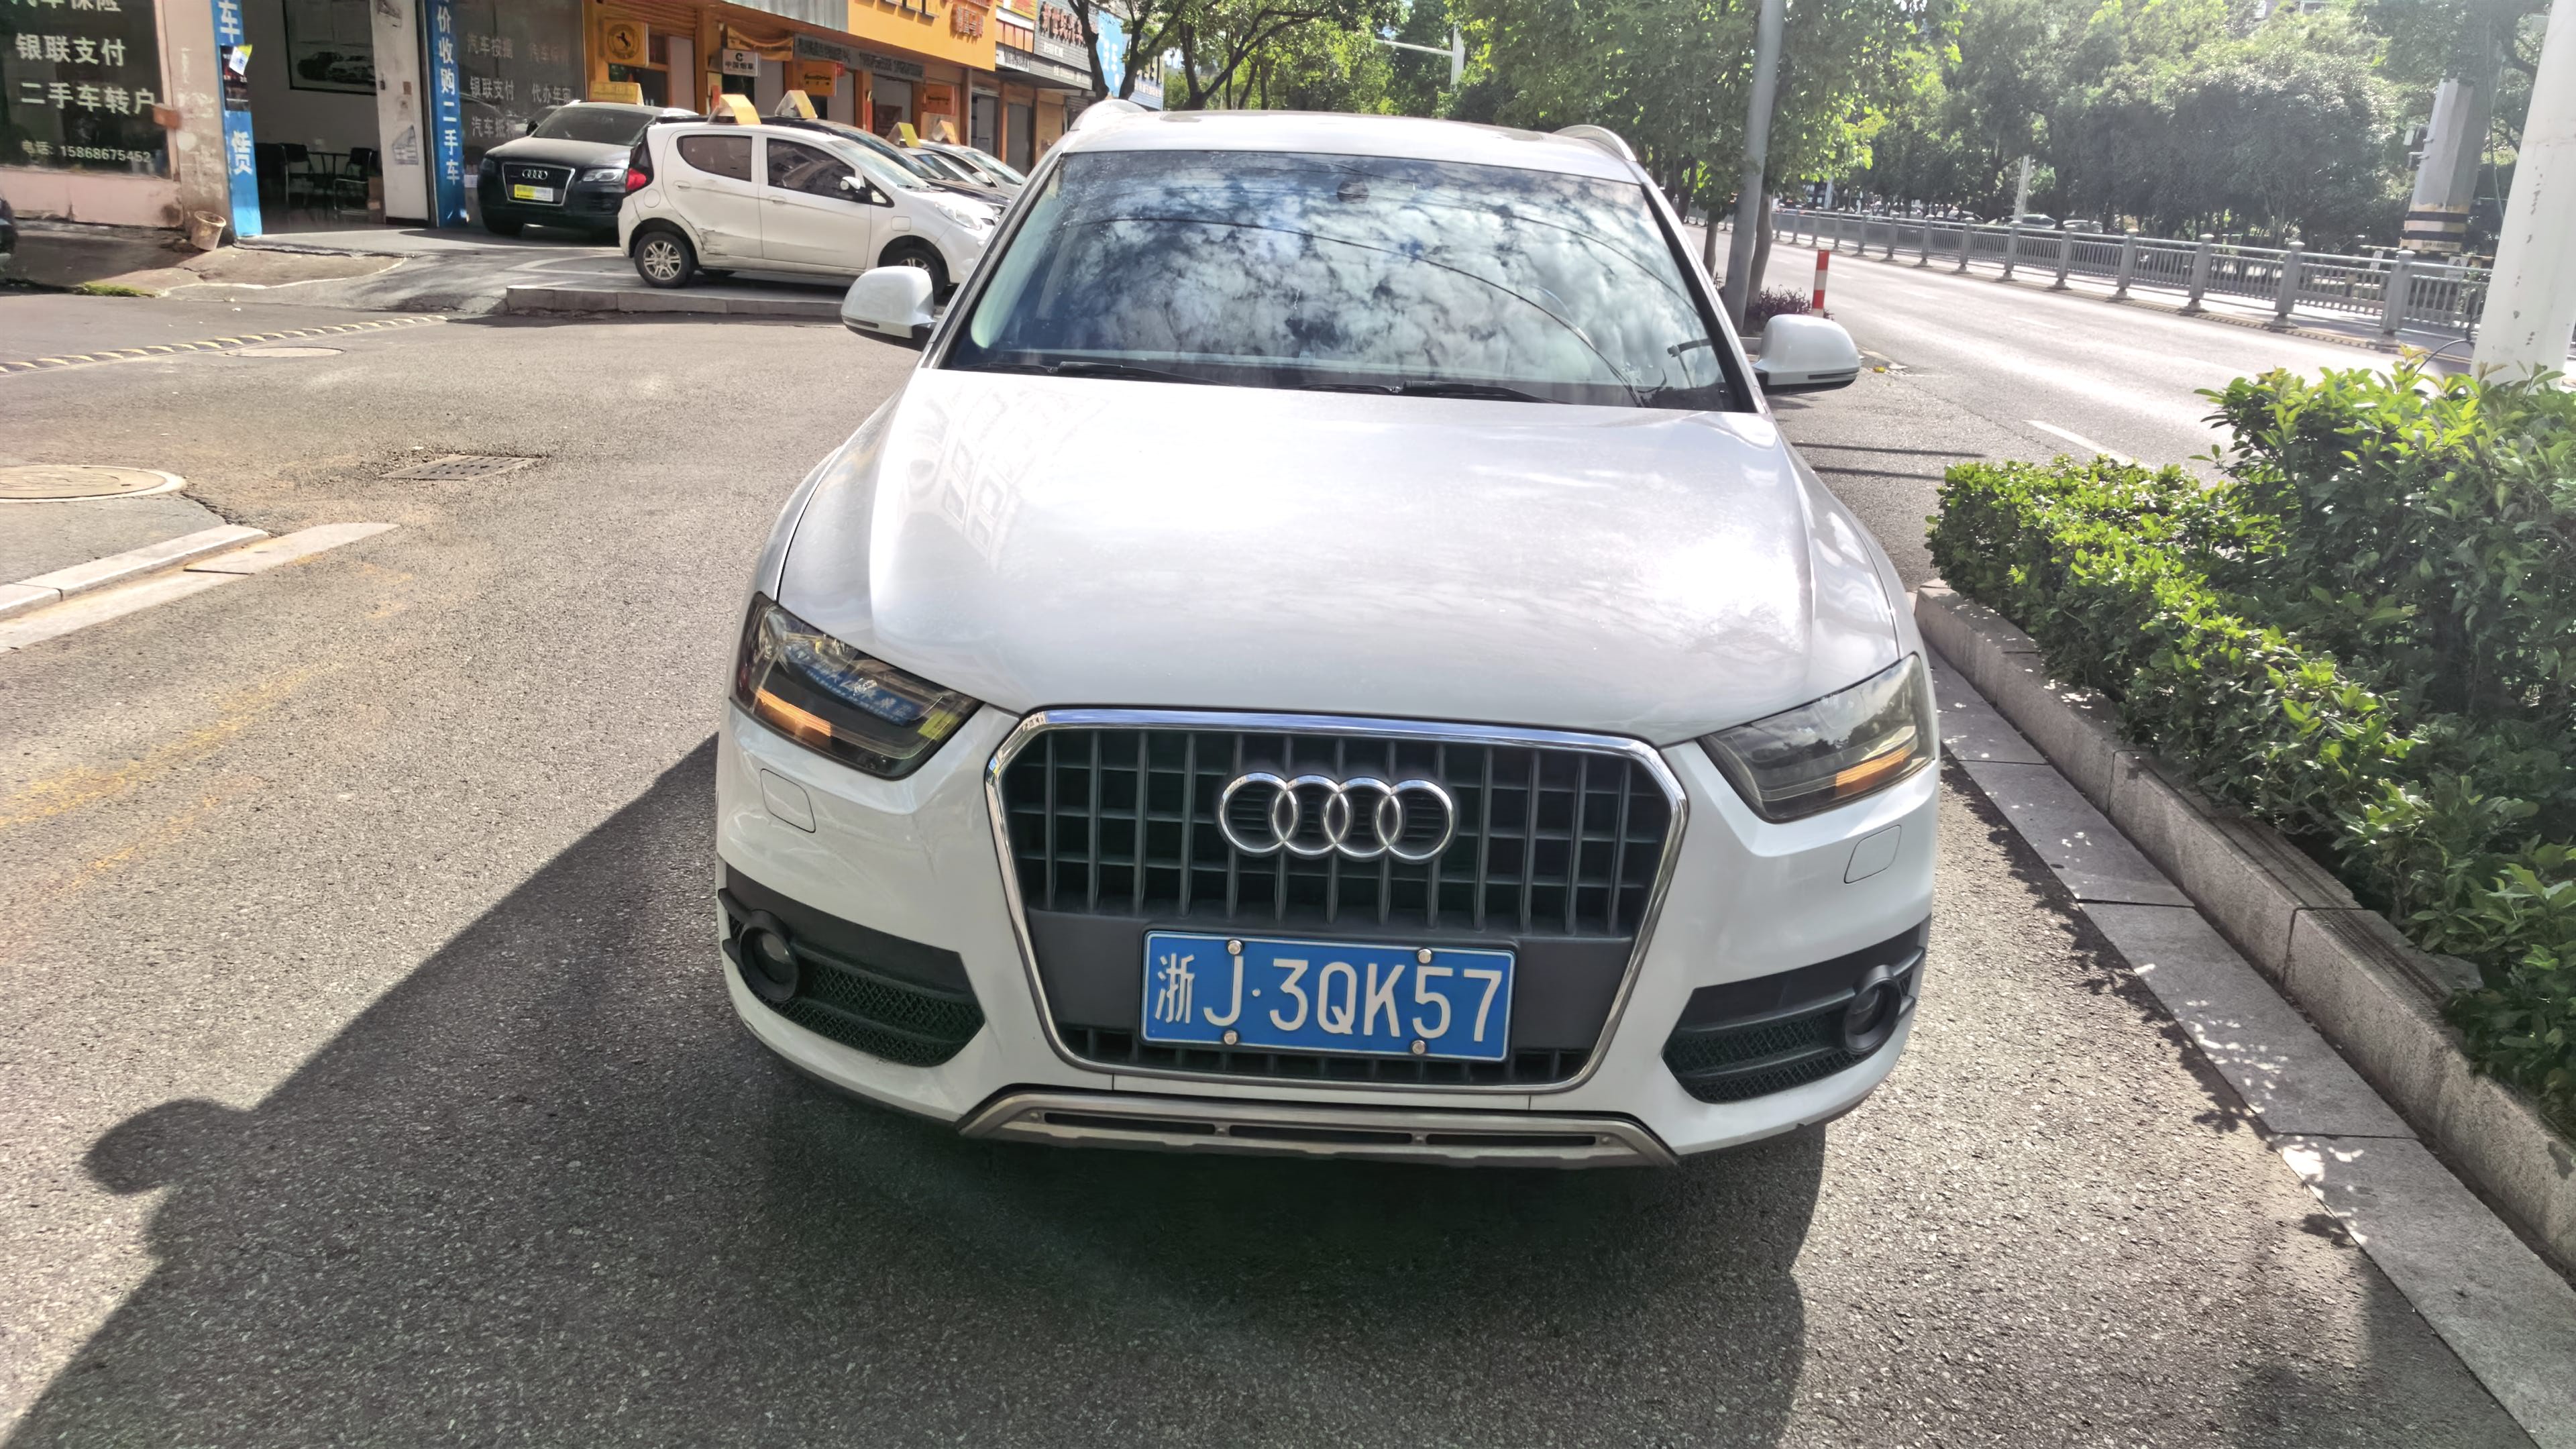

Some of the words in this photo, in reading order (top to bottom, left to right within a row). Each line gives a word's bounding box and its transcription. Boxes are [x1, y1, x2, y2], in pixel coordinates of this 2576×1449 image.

[15, 33, 127, 66] 银联支付
[21, 82, 156, 115] 二手车转户
[437, 0, 460, 186] 价收购二手车
[470, 76, 514, 101] 银联支付
[60, 145, 152, 163] 15868675452
[1155, 952, 1503, 1042] 浙J·3QK57
